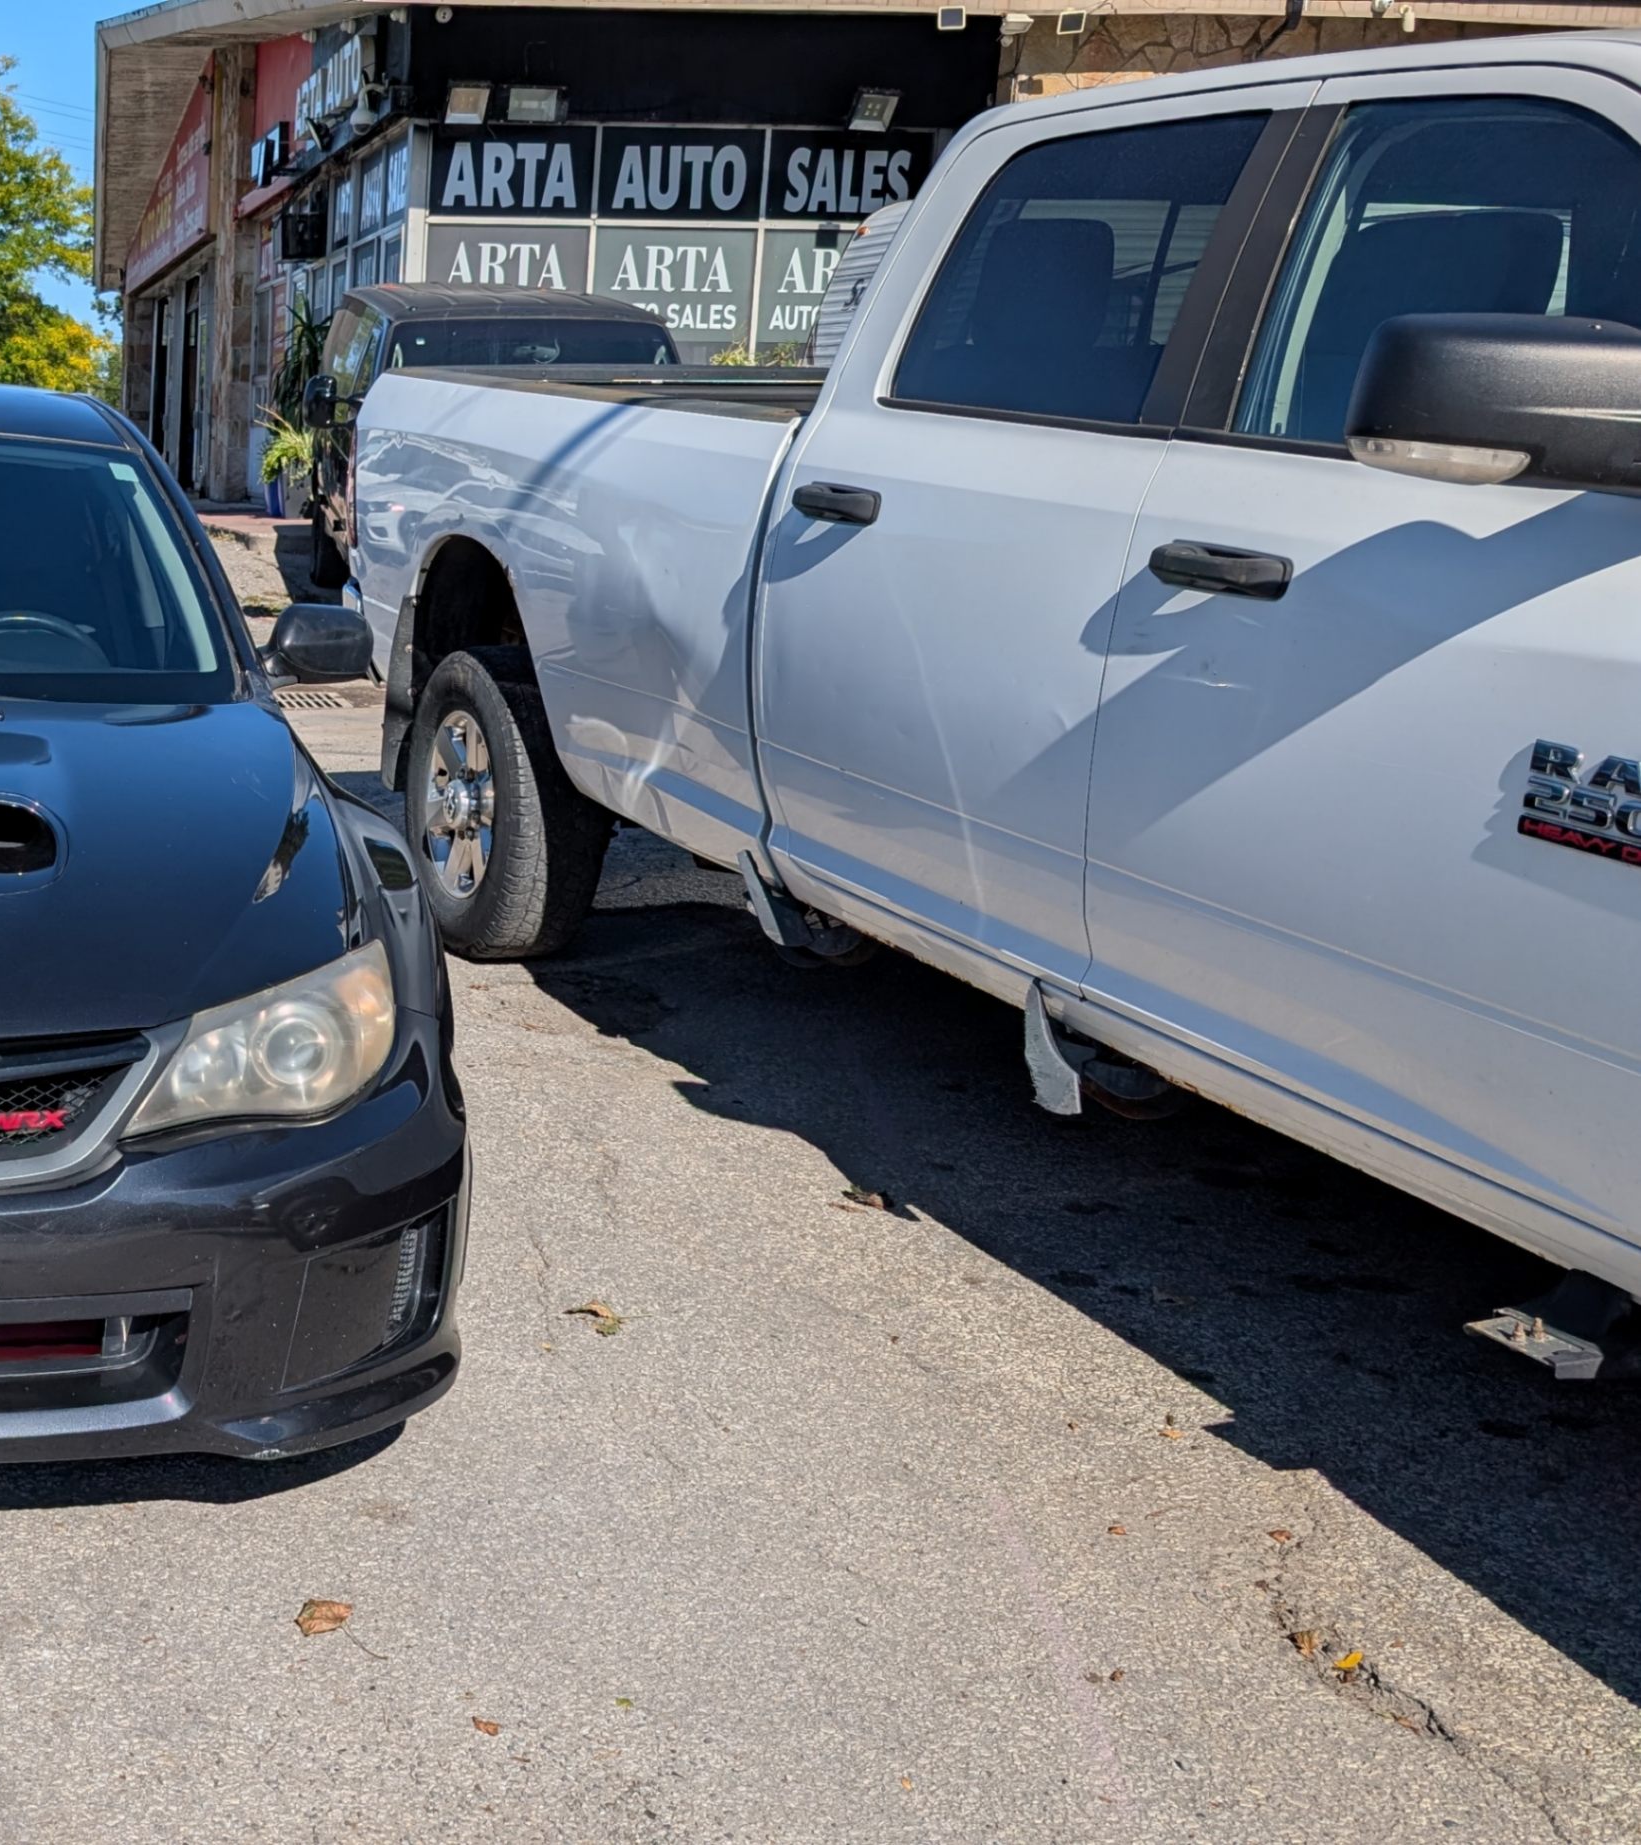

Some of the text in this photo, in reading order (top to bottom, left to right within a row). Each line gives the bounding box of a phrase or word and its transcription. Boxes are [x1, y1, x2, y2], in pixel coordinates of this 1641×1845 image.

[324, 34, 361, 116] AUTO
[387, 146, 407, 217] SALE
[441, 142, 912, 214] ARTA AUTO SALES
[448, 241, 566, 290] ARTA
[611, 244, 733, 293] ARTA
[777, 247, 841, 294] AR
[666, 304, 737, 330] SALES
[1530, 738, 1641, 796] RA
[1523, 775, 1641, 838] 25
[1522, 818, 1616, 853] HEAVY
